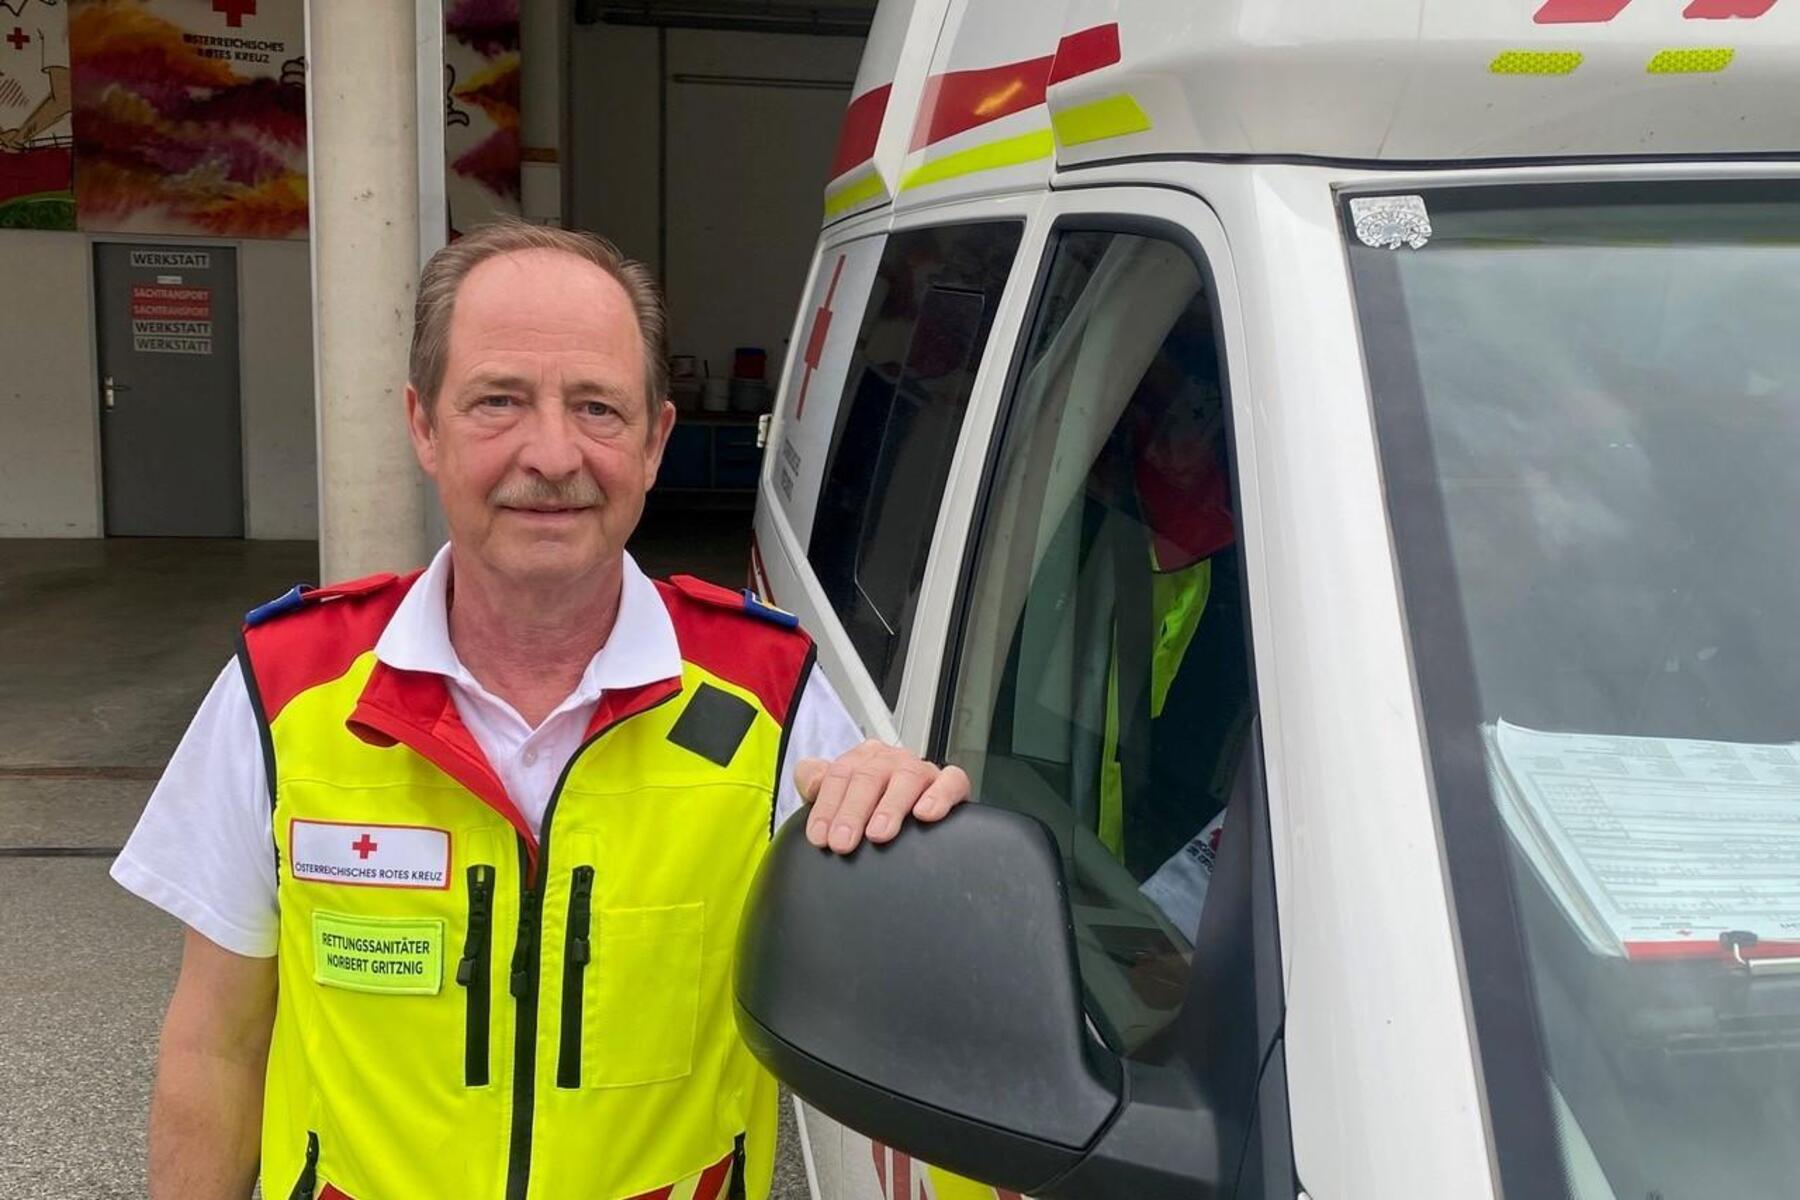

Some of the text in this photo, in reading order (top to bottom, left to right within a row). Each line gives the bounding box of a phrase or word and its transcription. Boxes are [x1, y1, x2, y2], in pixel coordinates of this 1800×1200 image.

[198, 48, 270, 63] ROTES KREUZ
[132, 252, 207, 266] WERKSTATT
[134, 321, 209, 335] WERKSTATT
[135, 338, 210, 352] WERKSTATT
[294, 862, 443, 882] ÖSTERREICHISCHES ROTES KREUZ
[321, 932, 430, 955] RETTUNGSSANITÄTER
[327, 954, 423, 975] NORBERT GRITZNIG
